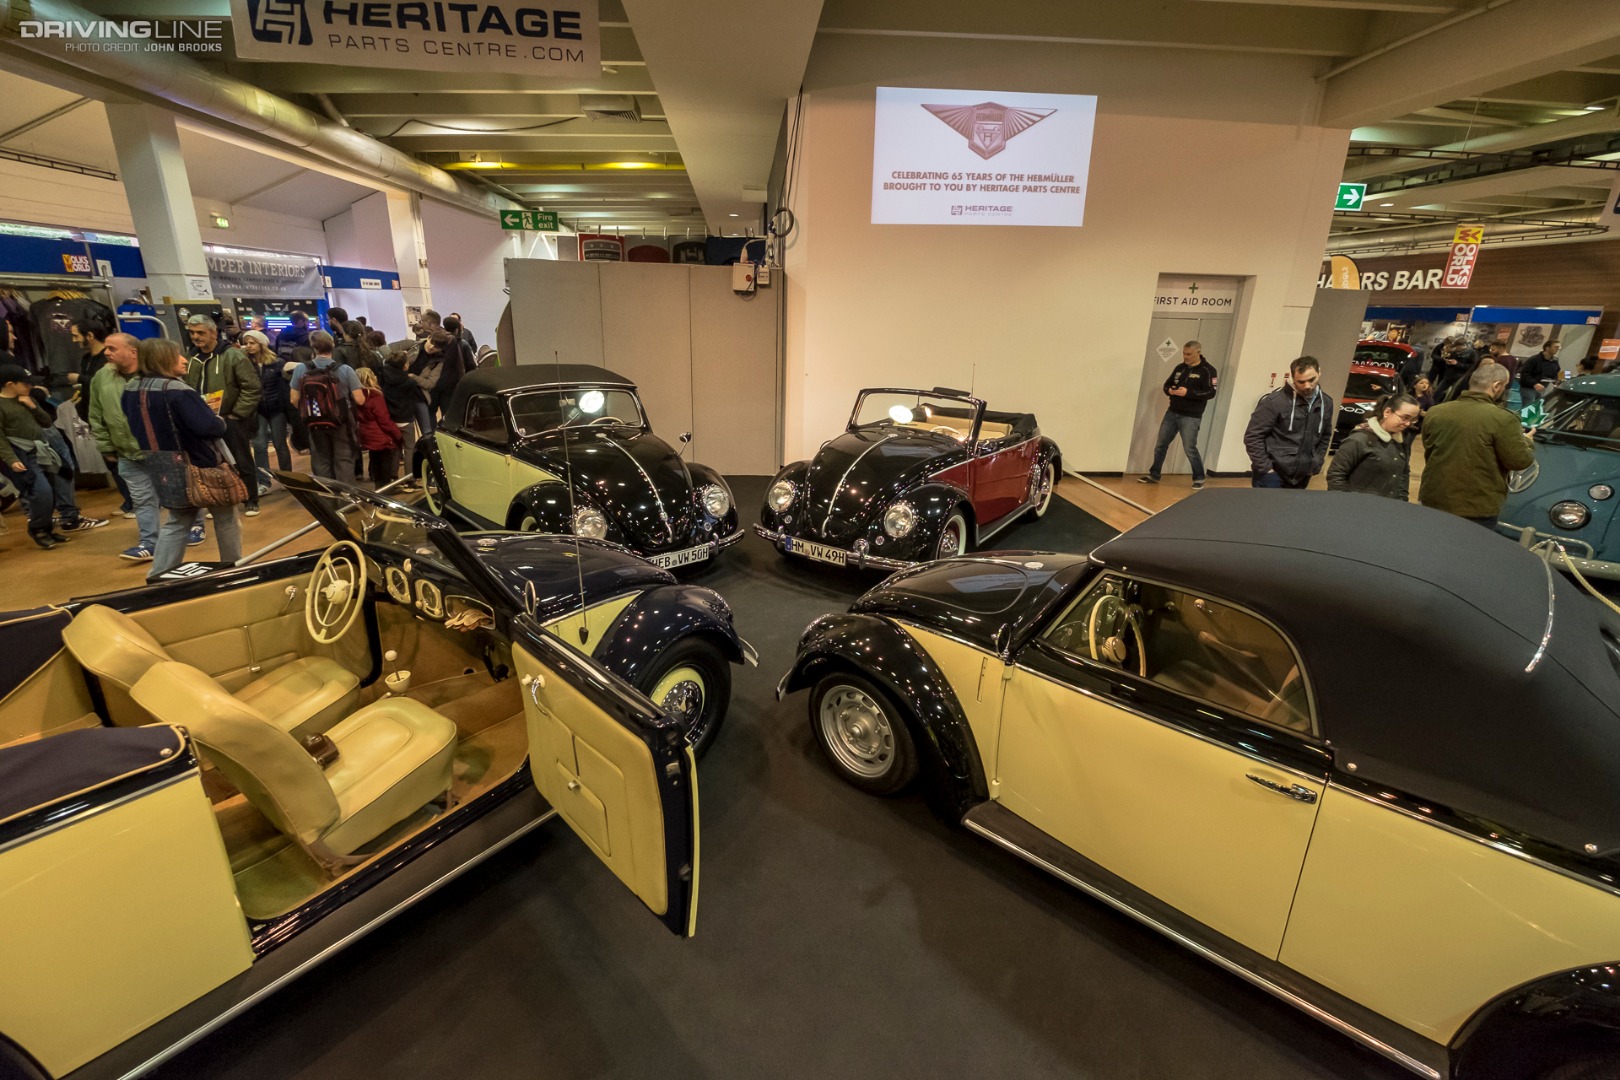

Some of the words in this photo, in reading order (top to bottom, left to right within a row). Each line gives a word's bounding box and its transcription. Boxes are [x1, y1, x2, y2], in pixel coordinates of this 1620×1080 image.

[323, 0, 583, 41] HERITAGE
[328, 34, 410, 53] PARTS
[891, 171, 949, 181] CELEBRATING
[951, 172, 963, 181] 65
[965, 172, 993, 182] YEARS
[995, 173, 1007, 182] OF
[1009, 173, 1025, 182] THE
[1027, 172, 1075, 183] HEBMÜLLER
[883, 182, 927, 191] BROUGHT
[929, 183, 941, 191] TO
[944, 183, 964, 192] YOU
[965, 183, 978, 192] BY
[979, 184, 1020, 193] HERITAGE
[1022, 185, 1048, 193] PARTS
[1050, 185, 1081, 194] CENTRE
[537, 213, 553, 221] Fire
[538, 220, 554, 229] exit
[206, 257, 246, 274] MPER
[249, 260, 306, 278] INTERIORS
[1392, 268, 1444, 291] BAR
[1181, 297, 1199, 306] AID
[1201, 298, 1232, 307] ROOM
[791, 540, 804, 552] HM
[825, 549, 845, 564] 49H
